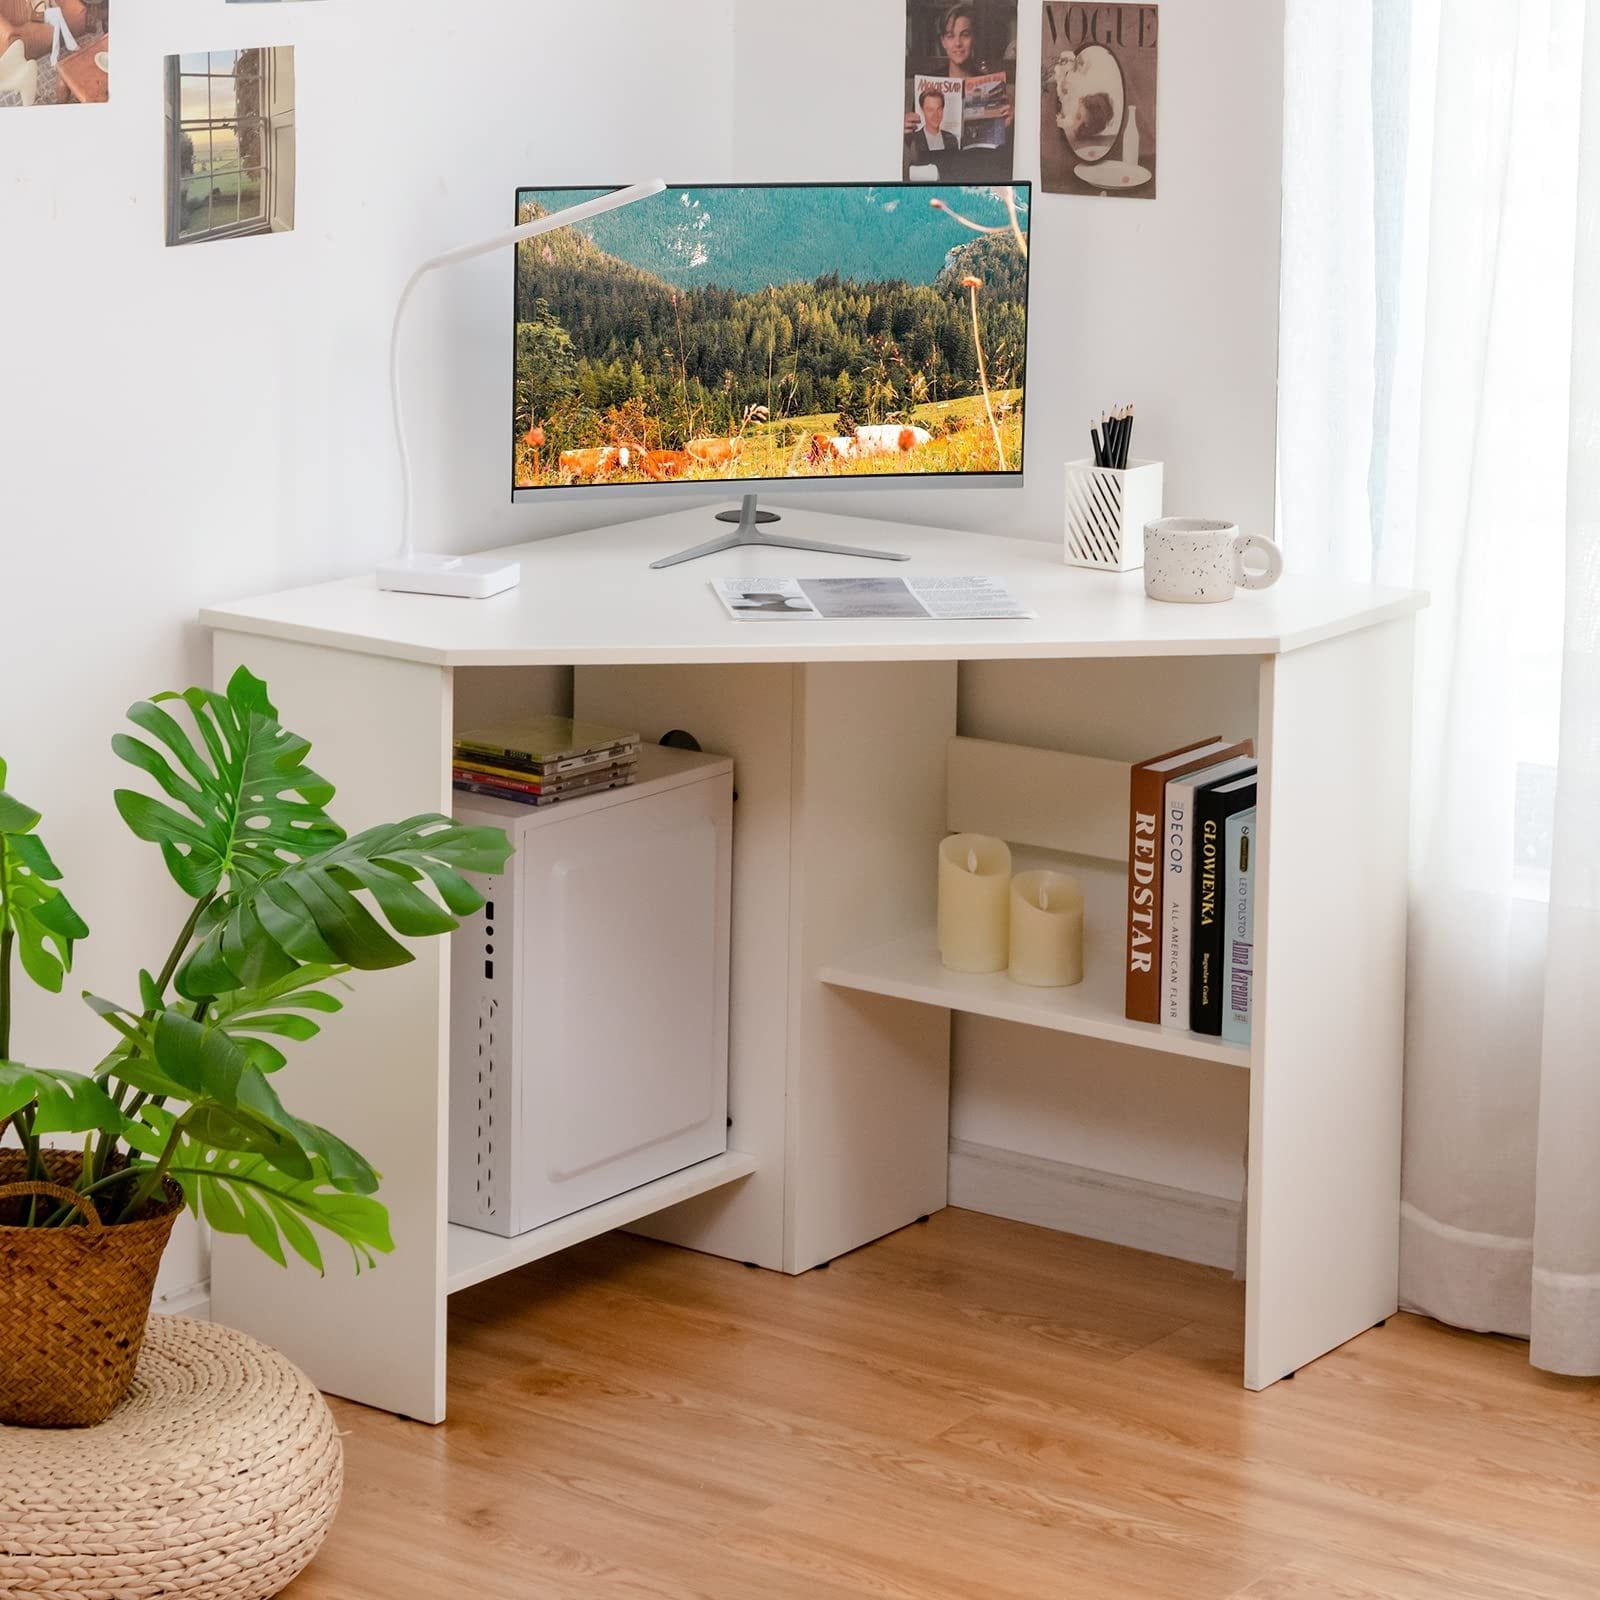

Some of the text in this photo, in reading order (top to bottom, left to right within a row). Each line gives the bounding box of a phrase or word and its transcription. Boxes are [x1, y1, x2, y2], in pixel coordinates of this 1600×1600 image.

[1044, 5, 1156, 48] VOGUE
[1169, 809, 1184, 874] DECOR
[1130, 811, 1156, 973] REDSTAR
[1239, 877, 1247, 895] LEO
[1237, 898, 1247, 939] TOLSTOY
[1169, 902, 1180, 1019] ALL-AMERICAN FLAIR
[1231, 939, 1254, 965] Anna
[1231, 967, 1253, 1013] Karenina
